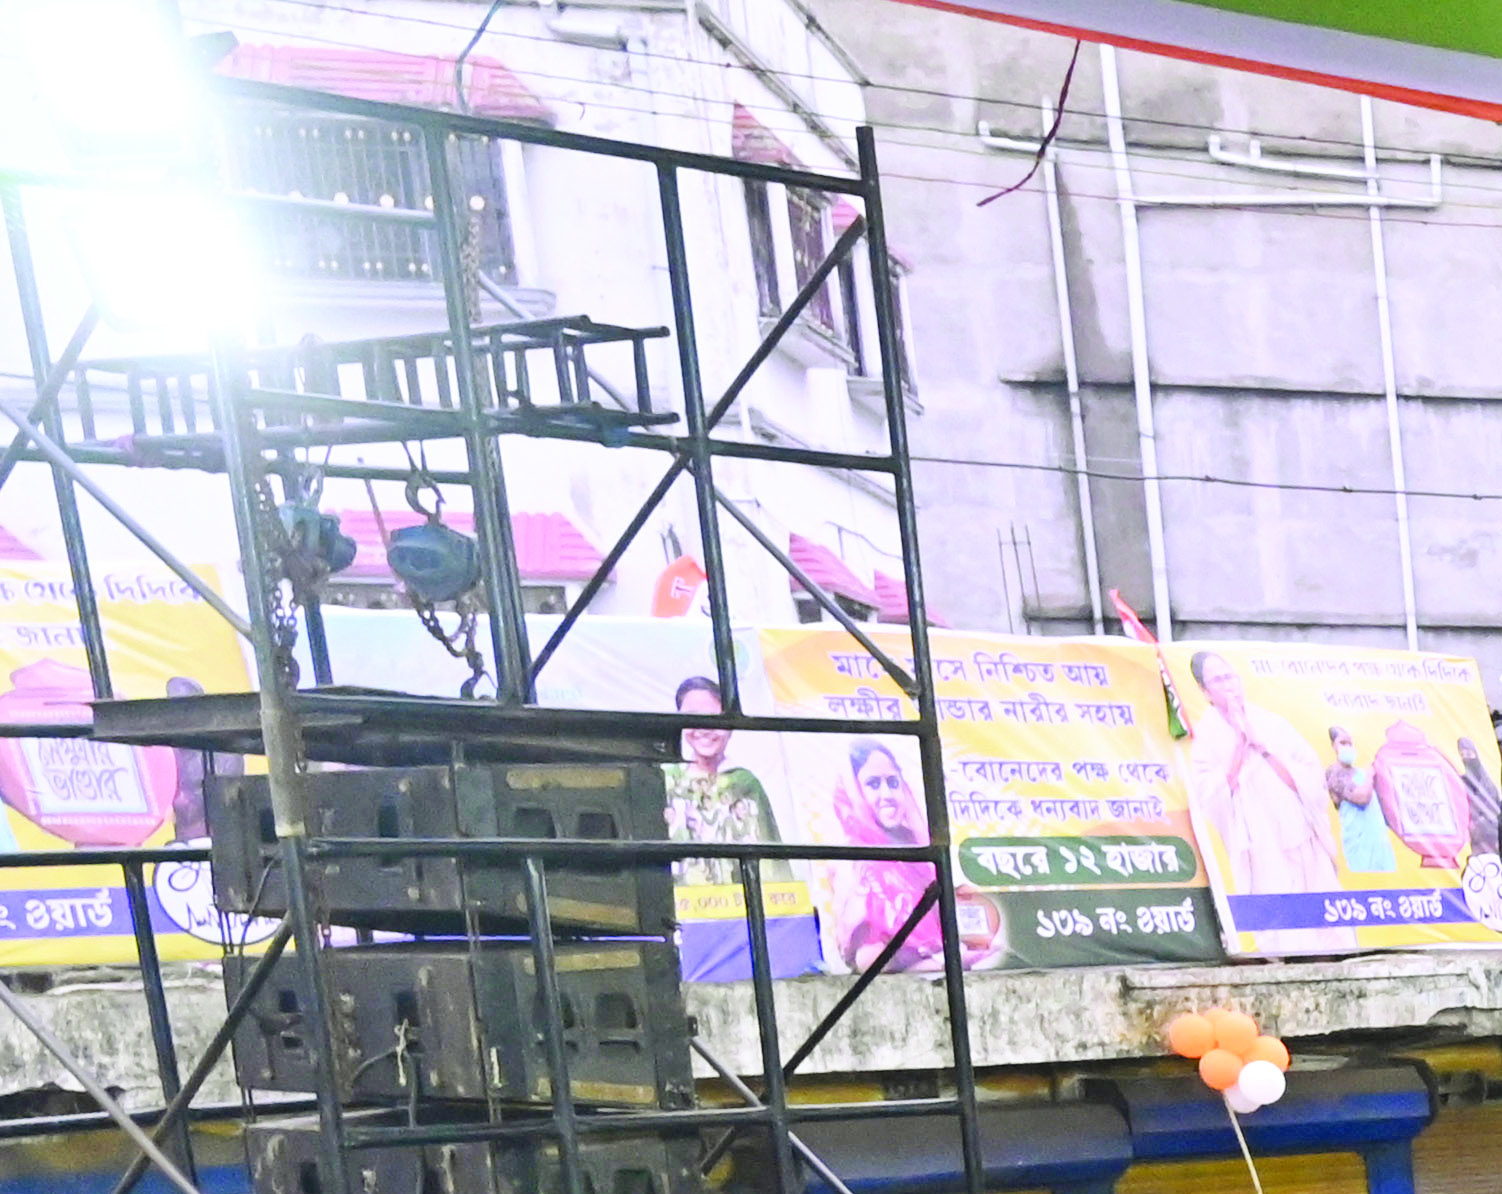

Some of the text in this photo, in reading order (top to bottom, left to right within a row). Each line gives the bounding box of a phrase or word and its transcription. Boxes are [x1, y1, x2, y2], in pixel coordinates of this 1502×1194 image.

[974, 651, 1055, 684] নিশ্চিত
[1062, 660, 1110, 687] আয়
[1000, 692, 1070, 724] নারীর
[1074, 701, 1135, 727] সহায়
[948, 761, 1064, 783] -বোনেদের
[1071, 761, 1109, 782] পক্ষ
[949, 790, 1024, 822] দিদিকে
[971, 841, 1181, 880] বছরে ১২ হাজার
[25, 887, 113, 929] ওয়ার্ড
[1036, 896, 1196, 938] ১৩৯ নং ওয়ার্ড
[1323, 897, 1369, 923] ১৩৯
[1369, 895, 1397, 920] নং
